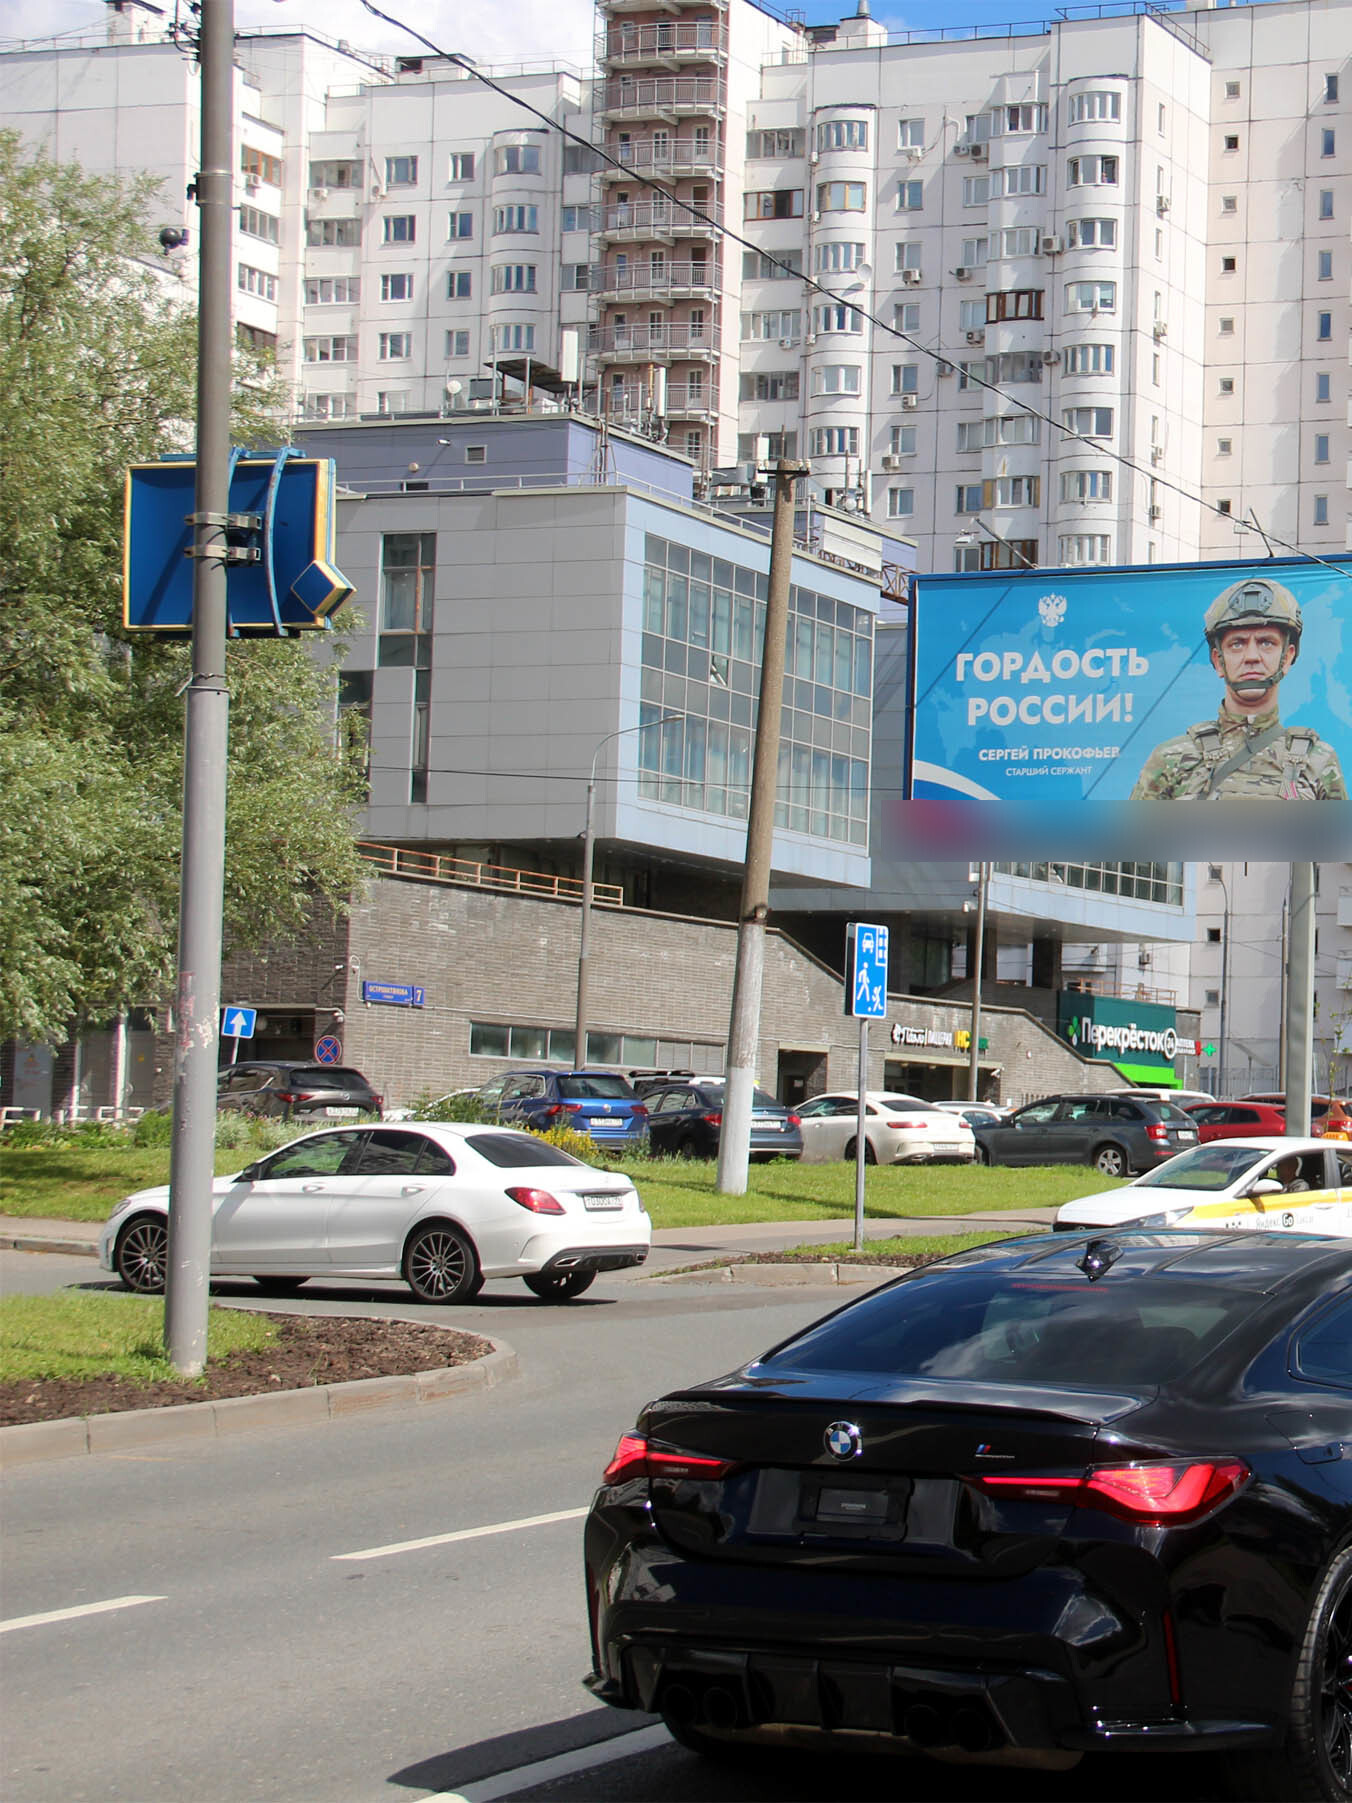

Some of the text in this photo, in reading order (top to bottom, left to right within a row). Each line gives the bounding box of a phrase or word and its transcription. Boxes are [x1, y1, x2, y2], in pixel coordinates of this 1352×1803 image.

[955, 648, 1150, 683] ГОРДОСТЬ
[967, 692, 1134, 727] РОССИИ!
[978, 745, 1121, 761] СЕРГЕЙ ПРОКОФЬЕВ
[1005, 765, 1093, 777] СТАРШИЙ СЕРЖАНТ
[416, 990, 421, 1001] 7
[1081, 1017, 1165, 1055] Перекрёсток
[1284, 1214, 1294, 1227] Go
